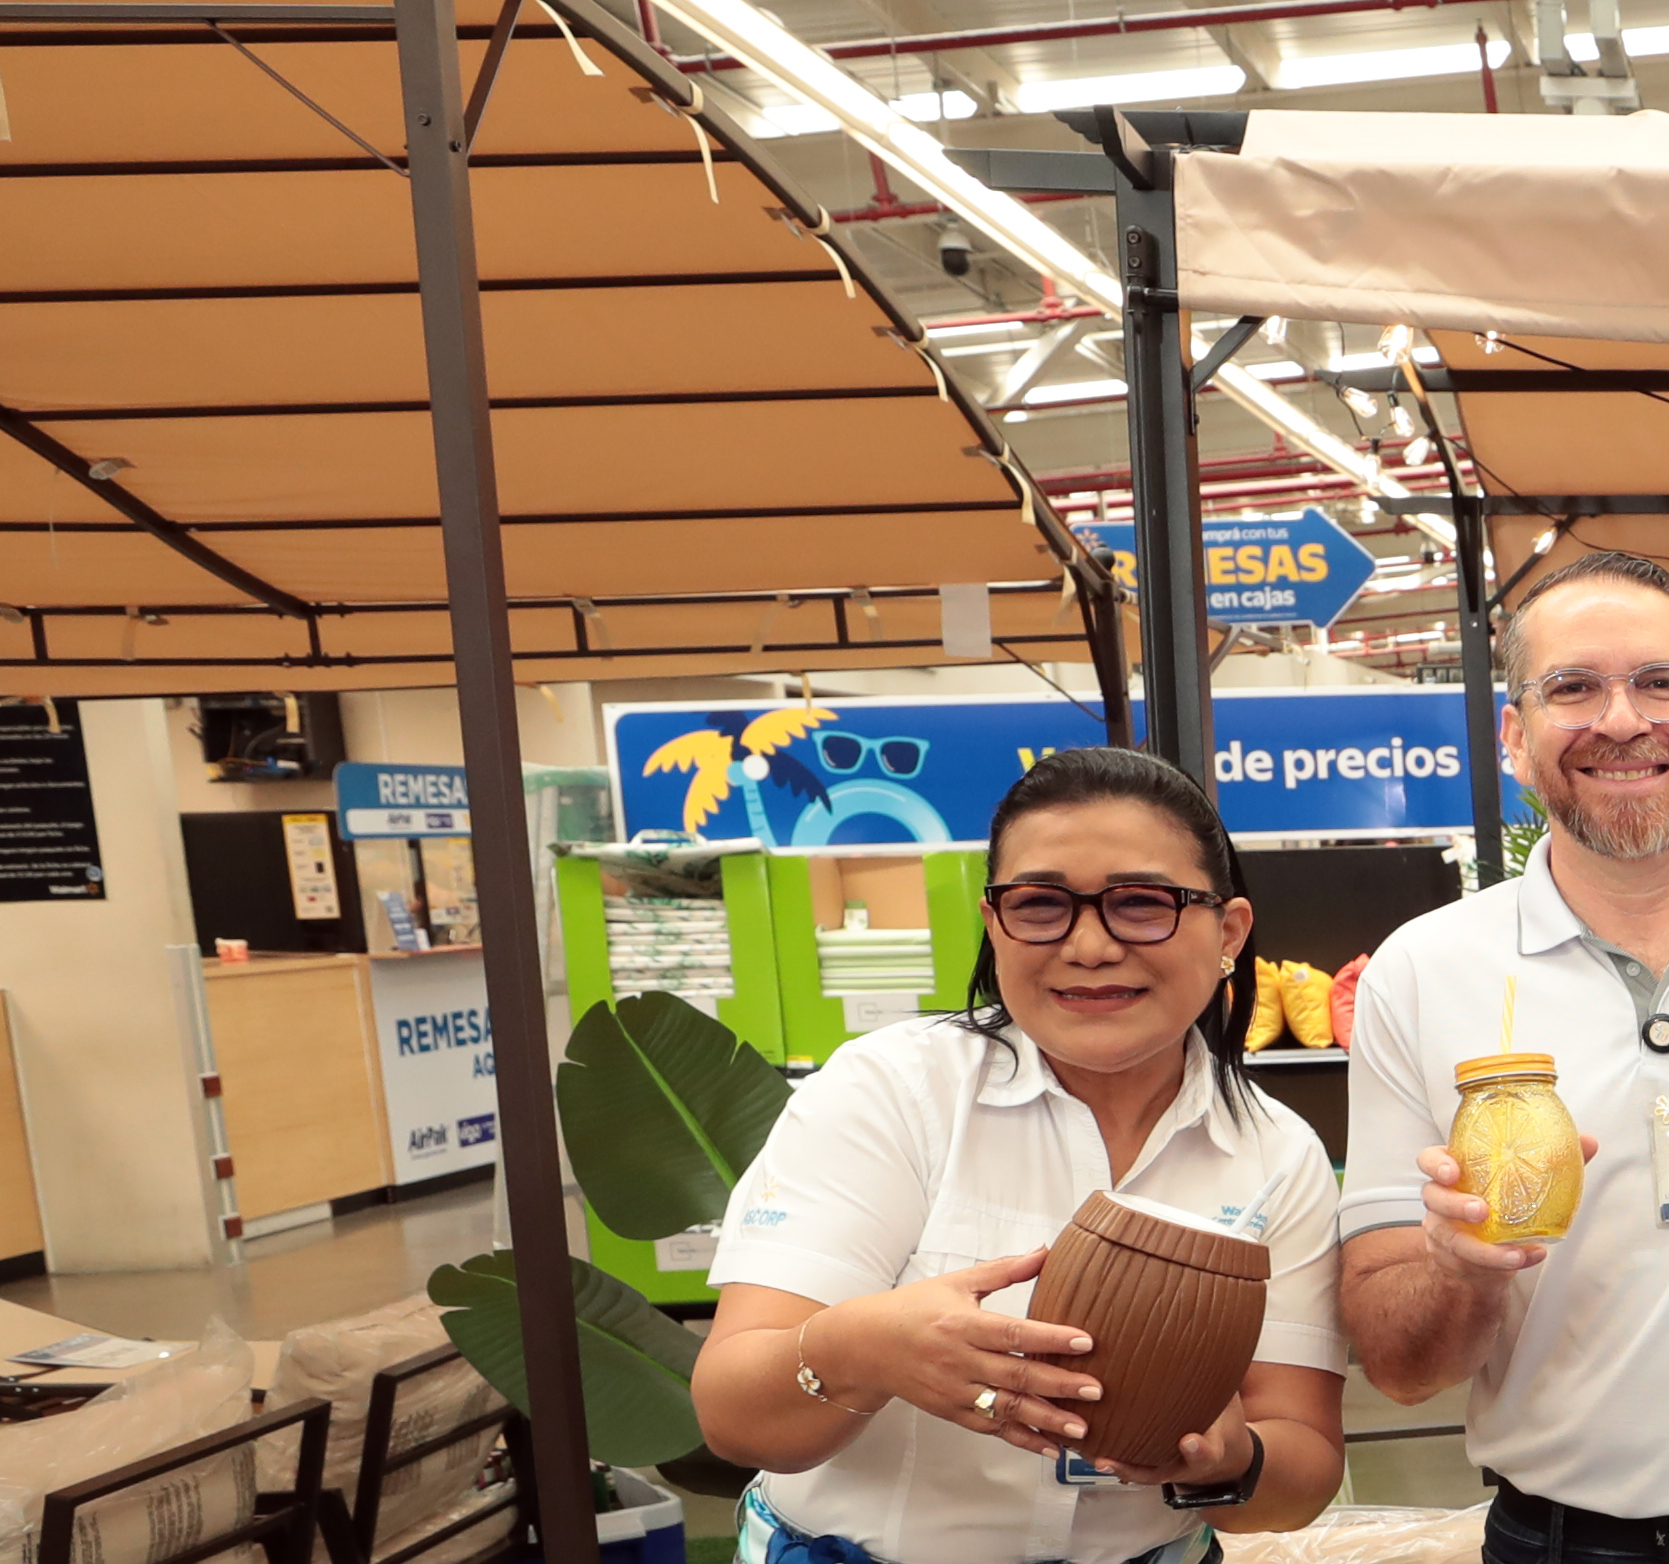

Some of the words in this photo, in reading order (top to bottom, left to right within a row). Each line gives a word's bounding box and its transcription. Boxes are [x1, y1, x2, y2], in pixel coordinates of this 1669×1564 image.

[1241, 528, 1267, 541] con
[1268, 527, 1289, 540] tus
[1112, 543, 1329, 588] RESAS
[1210, 592, 1239, 609] en
[1241, 588, 1296, 610] cajas
[1214, 740, 1273, 783] de
[1283, 736, 1461, 789] precios
[377, 772, 469, 805] REMESA
